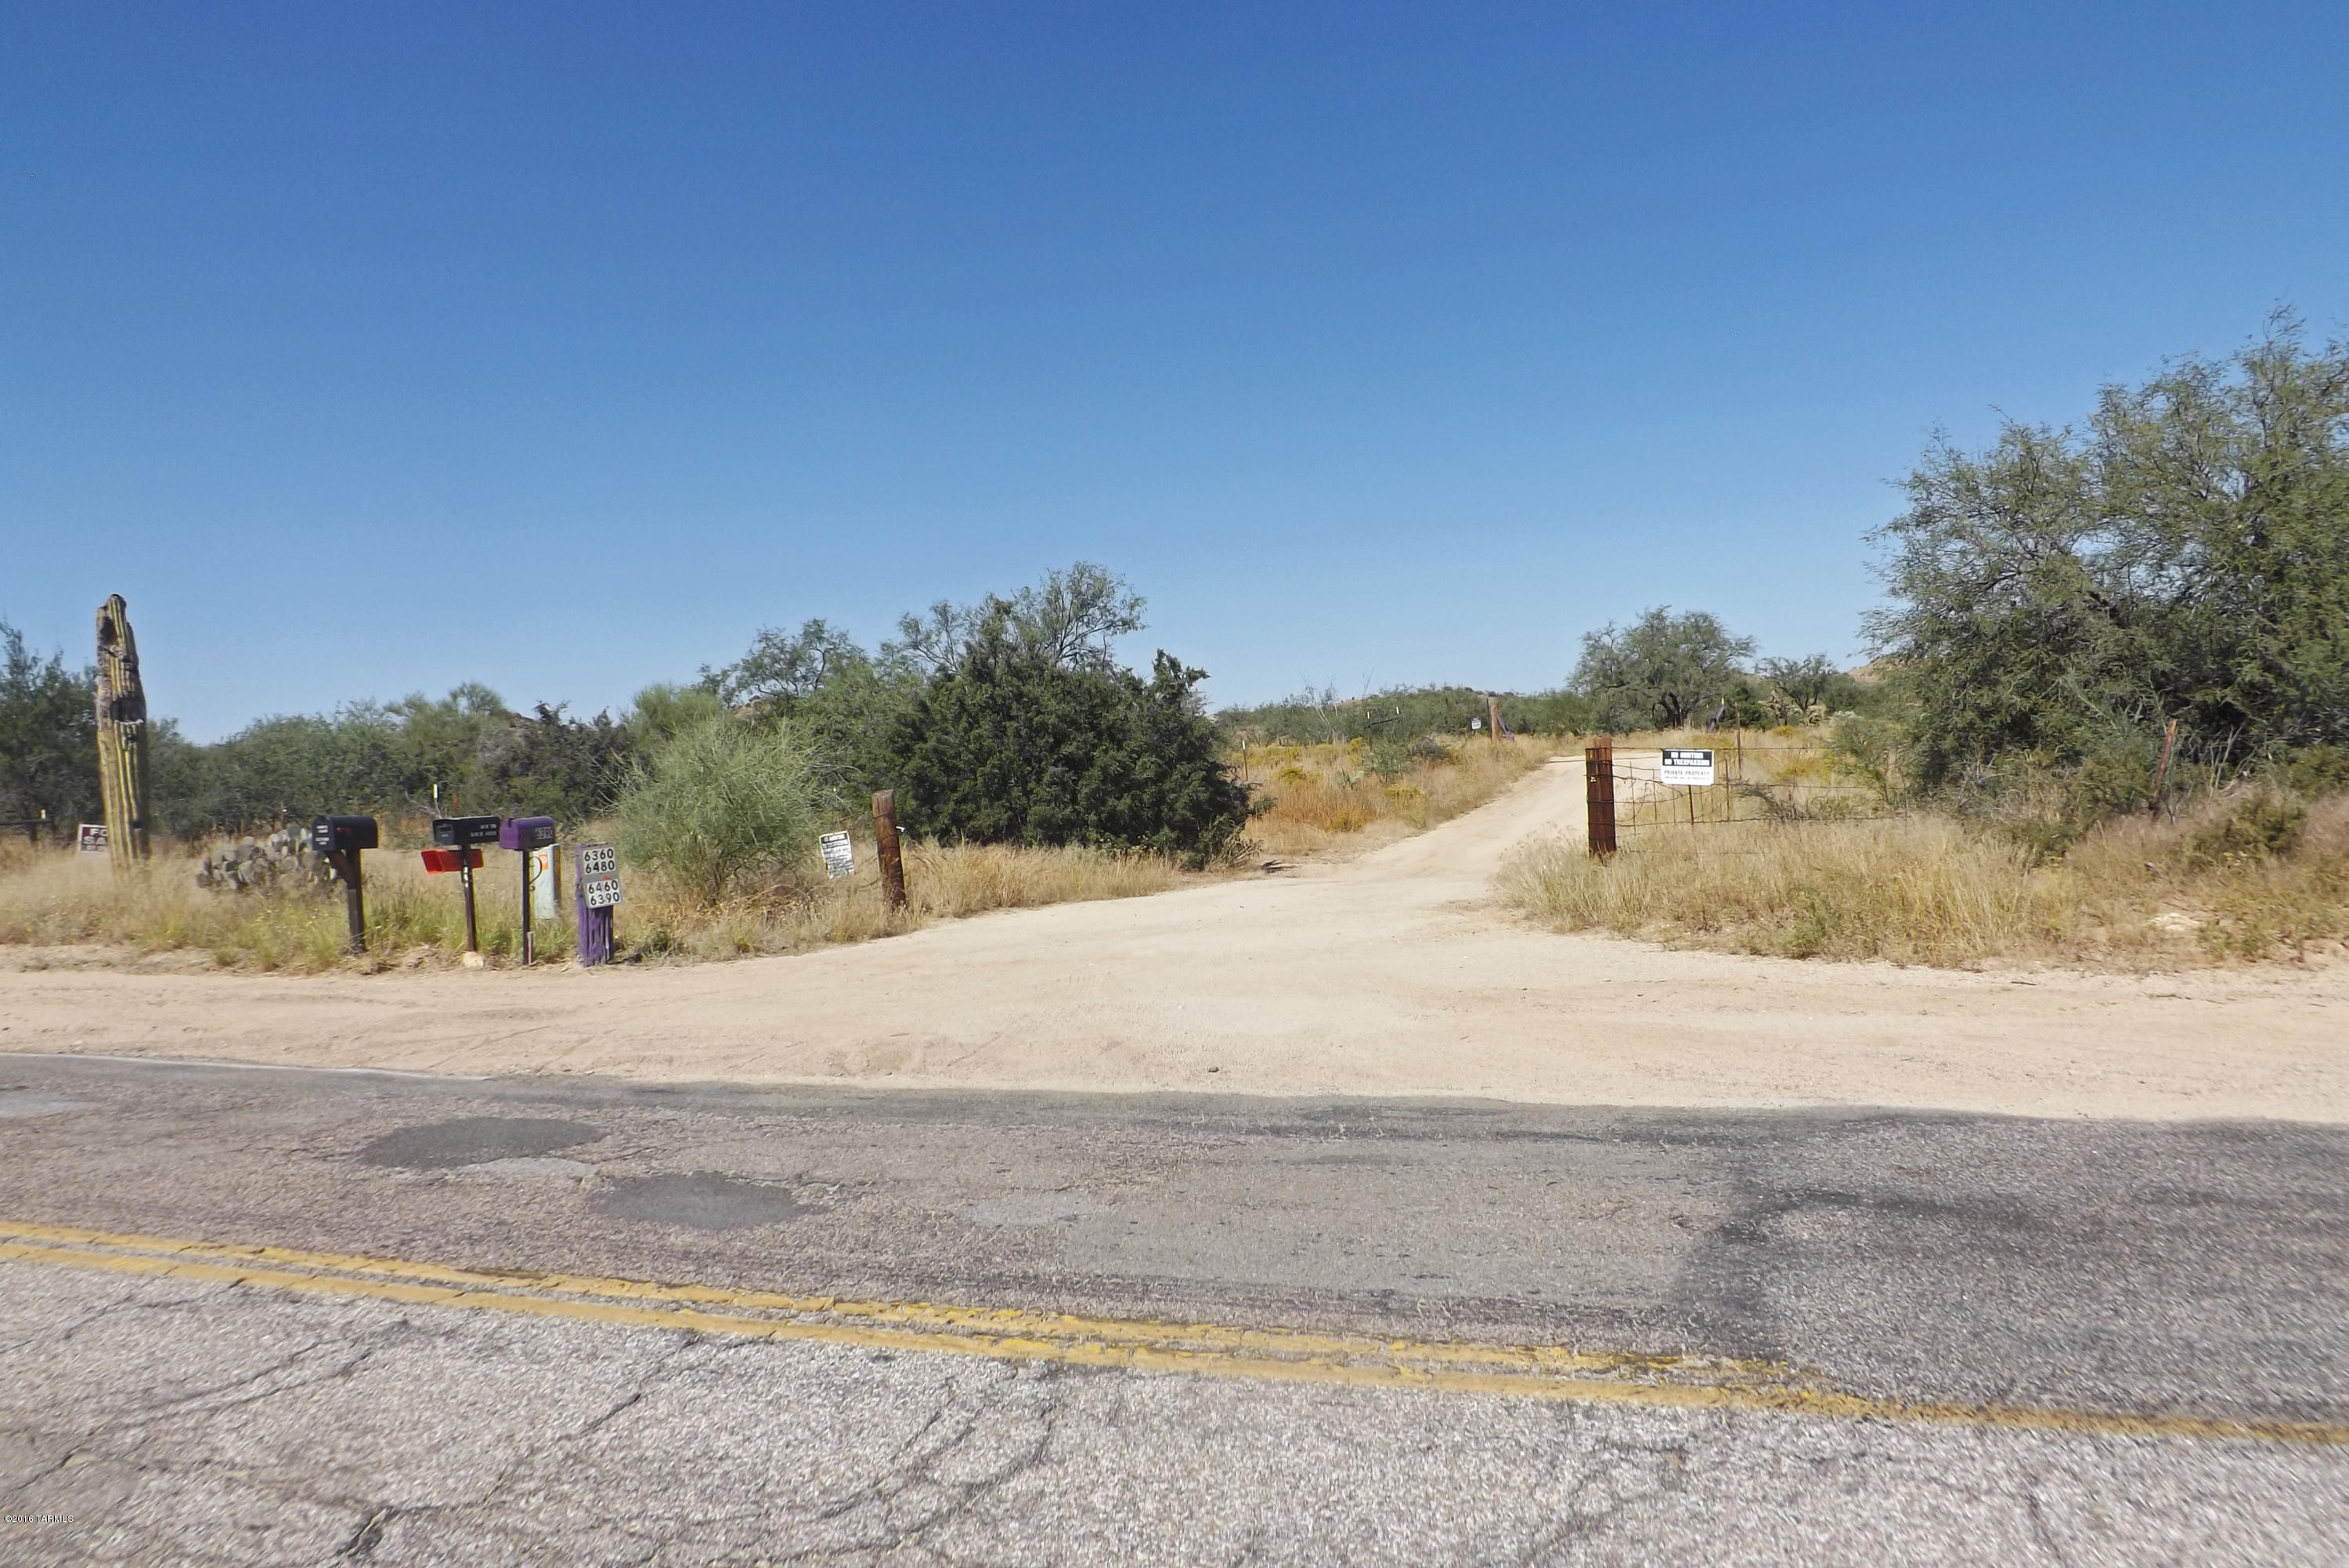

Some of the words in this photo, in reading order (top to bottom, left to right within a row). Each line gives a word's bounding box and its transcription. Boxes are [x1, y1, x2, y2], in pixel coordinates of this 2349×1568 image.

[89, 828, 108, 837] FO
[83, 836, 107, 845] SA
[584, 848, 614, 862] 6360
[585, 860, 615, 874] 6480
[588, 880, 619, 894] 6460
[590, 892, 620, 906] 6390
